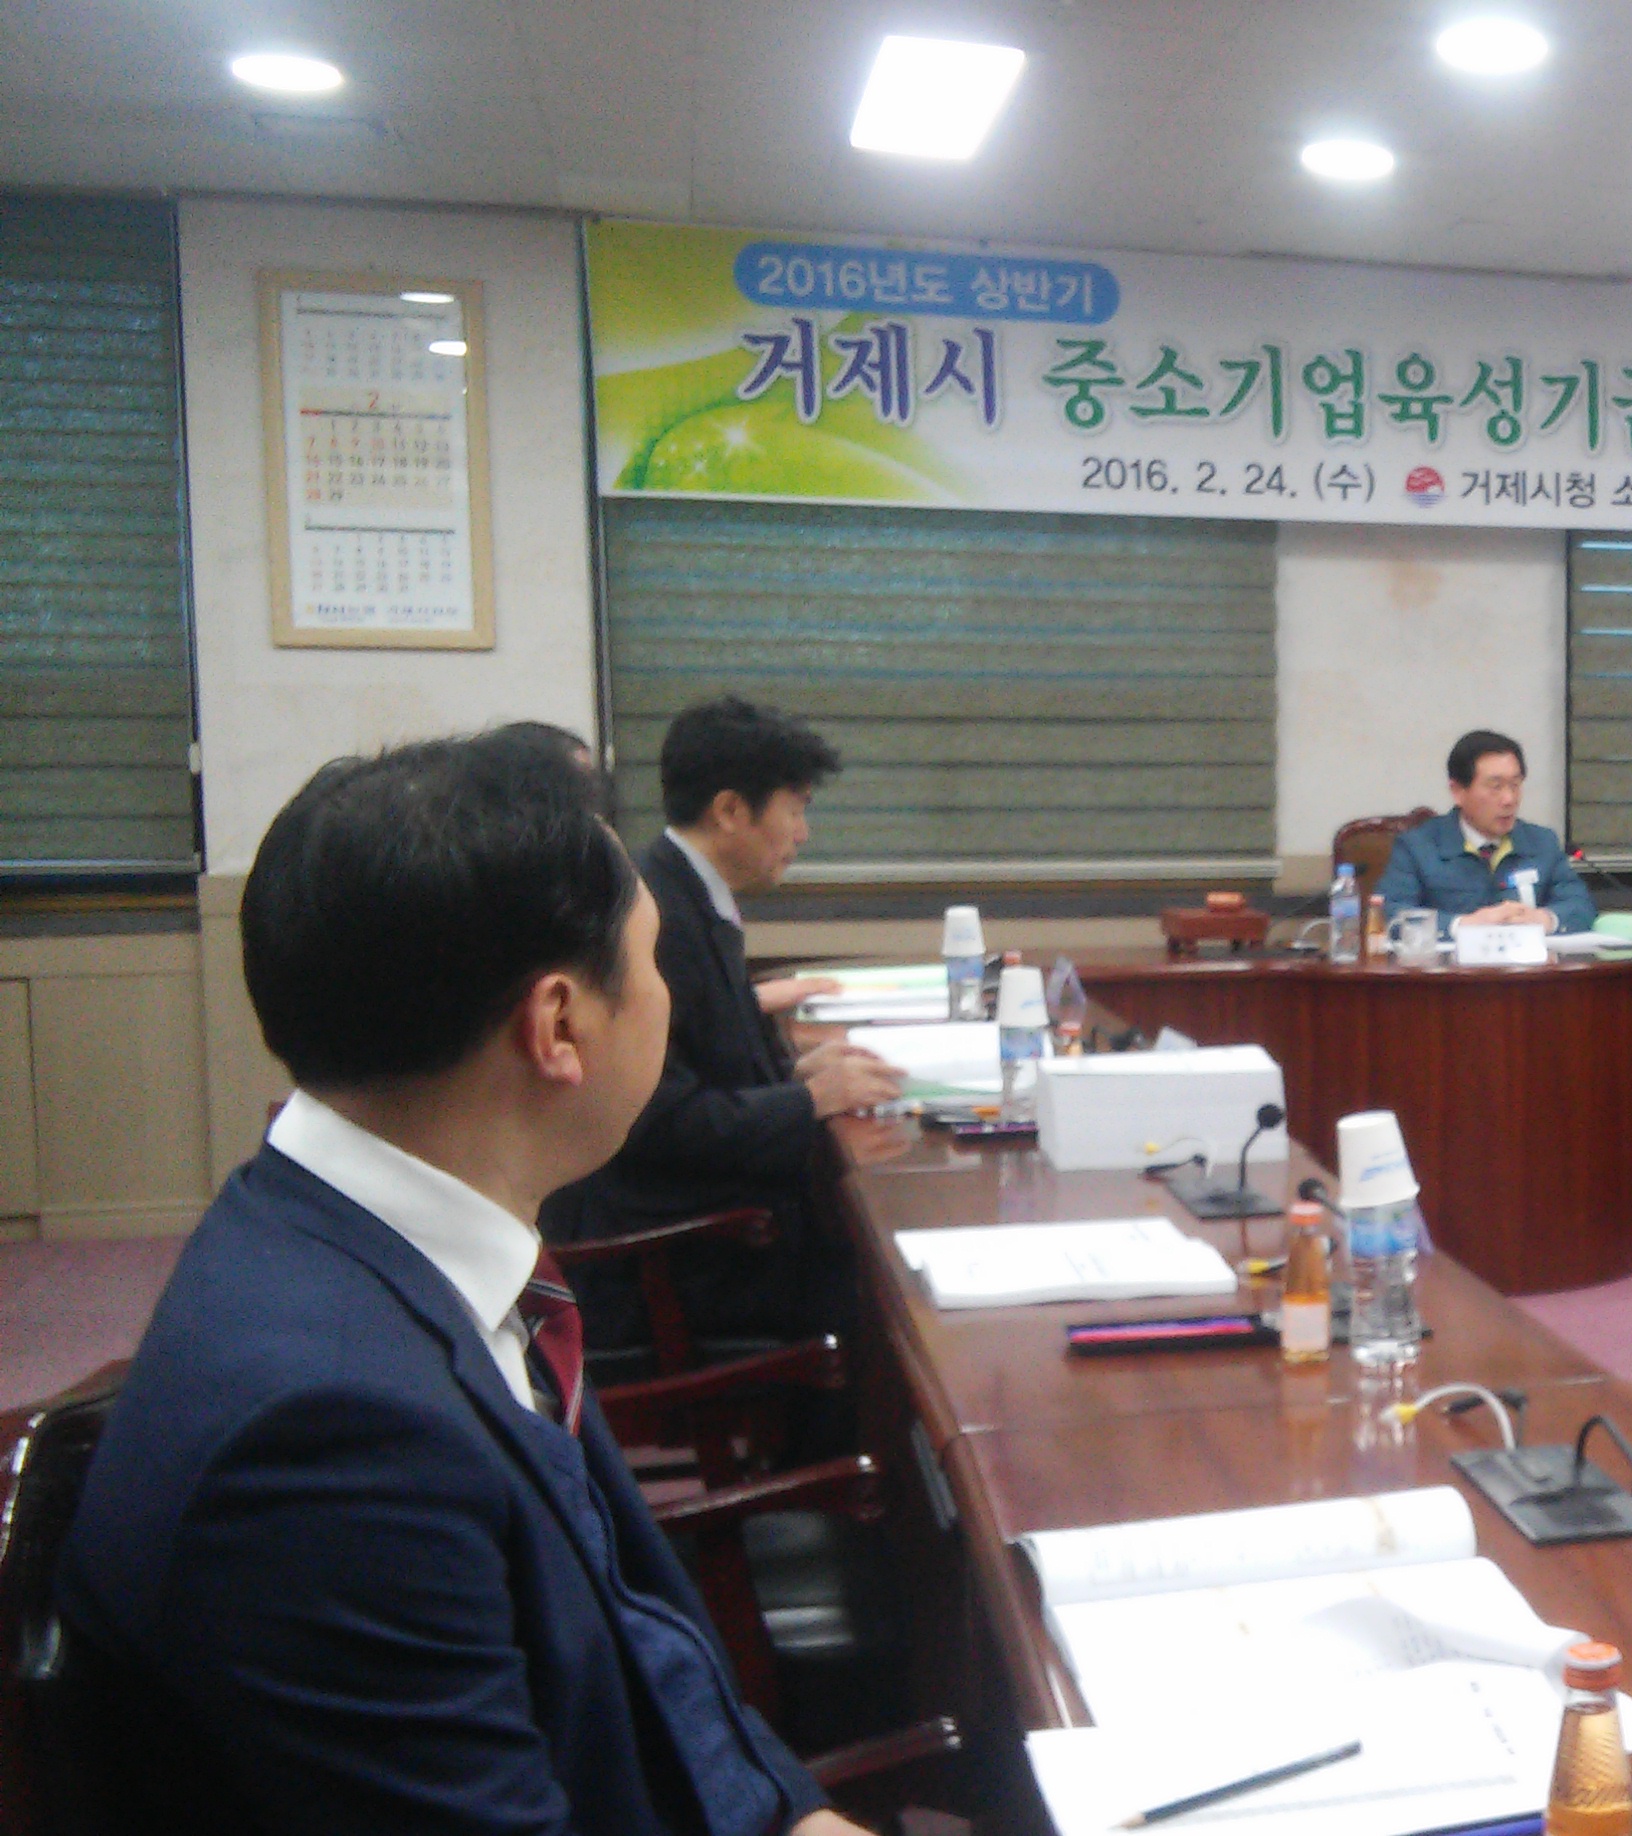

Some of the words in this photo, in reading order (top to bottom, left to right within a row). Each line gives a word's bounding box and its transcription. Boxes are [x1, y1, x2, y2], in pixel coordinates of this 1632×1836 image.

[757, 254, 954, 302] 2016년도
[970, 265, 1095, 316] 상반기
[740, 318, 998, 425] 거제시
[1081, 456, 1179, 495] 2016.
[1195, 461, 1228, 496] 2.
[1244, 463, 1298, 498] 24.
[1313, 462, 1376, 502] (수)
[1461, 470, 1597, 509] 거제시청
